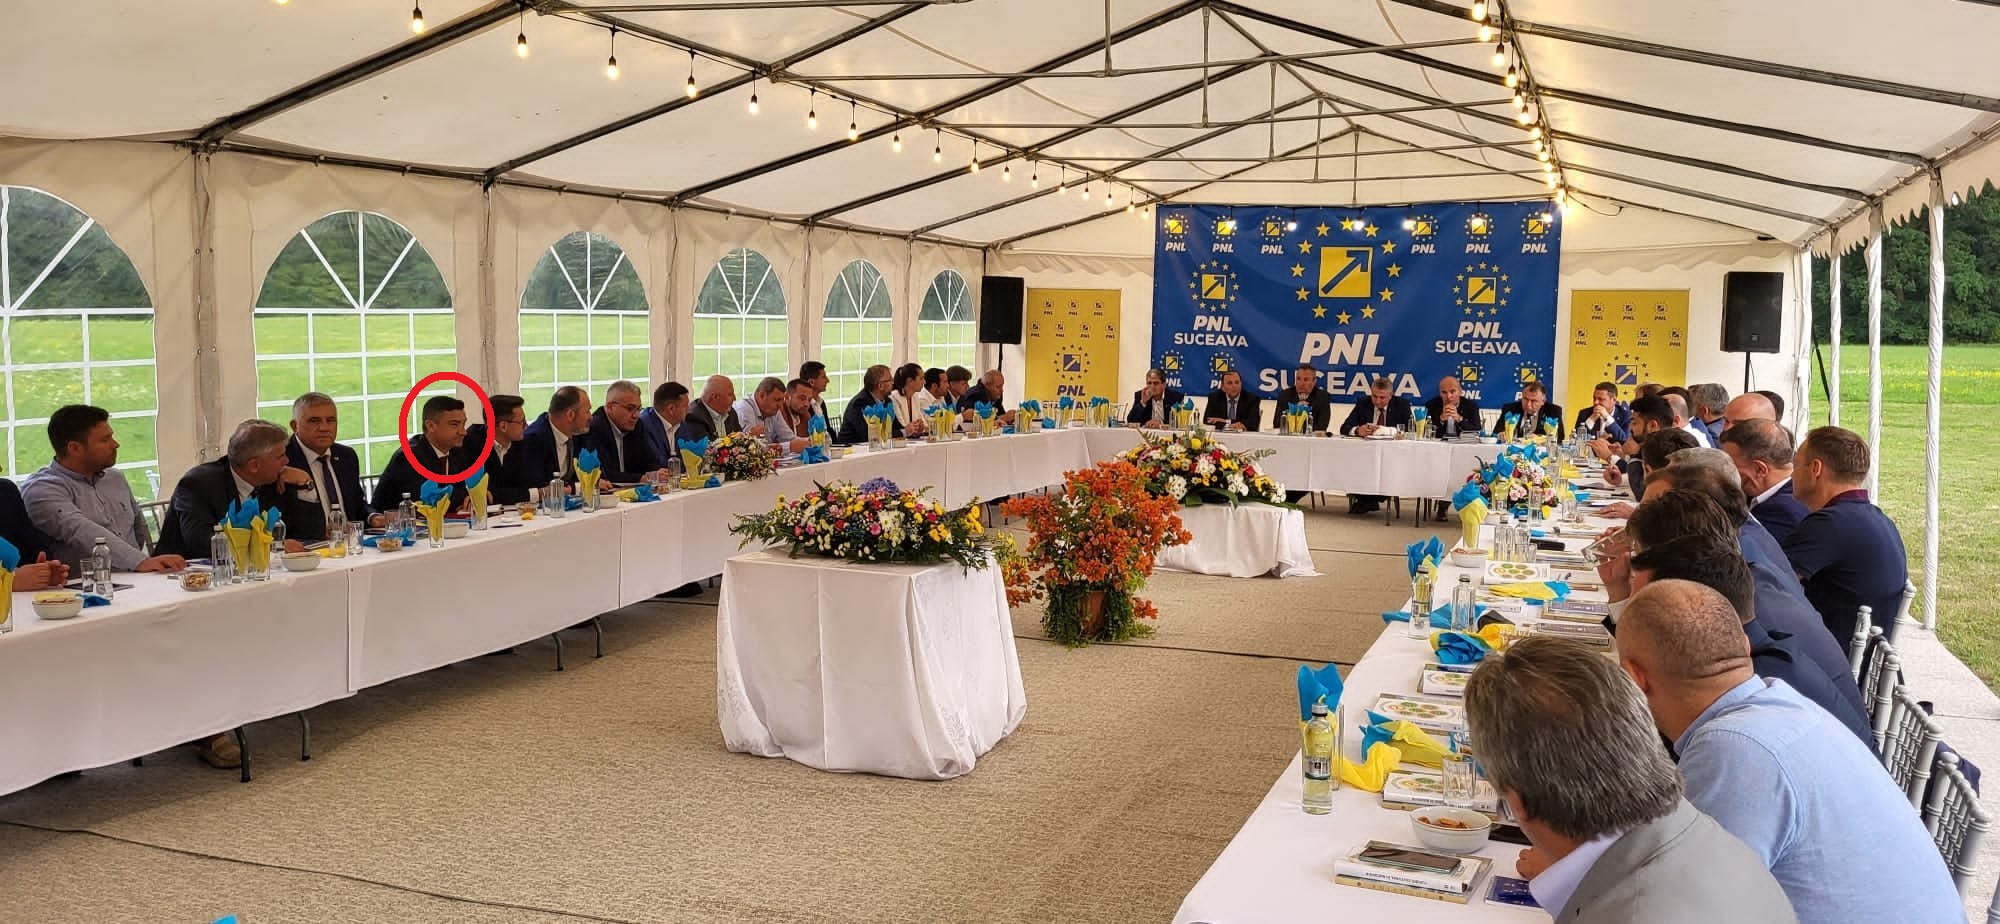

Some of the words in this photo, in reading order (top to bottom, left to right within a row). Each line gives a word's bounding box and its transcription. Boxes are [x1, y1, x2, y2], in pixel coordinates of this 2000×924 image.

[1165, 242, 1186, 251] PNL
[1212, 243, 1234, 253] PNL
[1261, 245, 1284, 254] PNL
[1411, 244, 1436, 254] PNL
[1465, 243, 1491, 253] PNL
[1521, 243, 1548, 253] PNL
[1193, 315, 1232, 332] PNL
[1457, 321, 1503, 339] PNL
[1174, 332, 1249, 348] SUCEAVA
[1300, 332, 1385, 366] PNL
[1435, 340, 1521, 355] SUCEAVA
[1258, 367, 1421, 398] SUEAA
[1057, 384, 1086, 396] PNL
